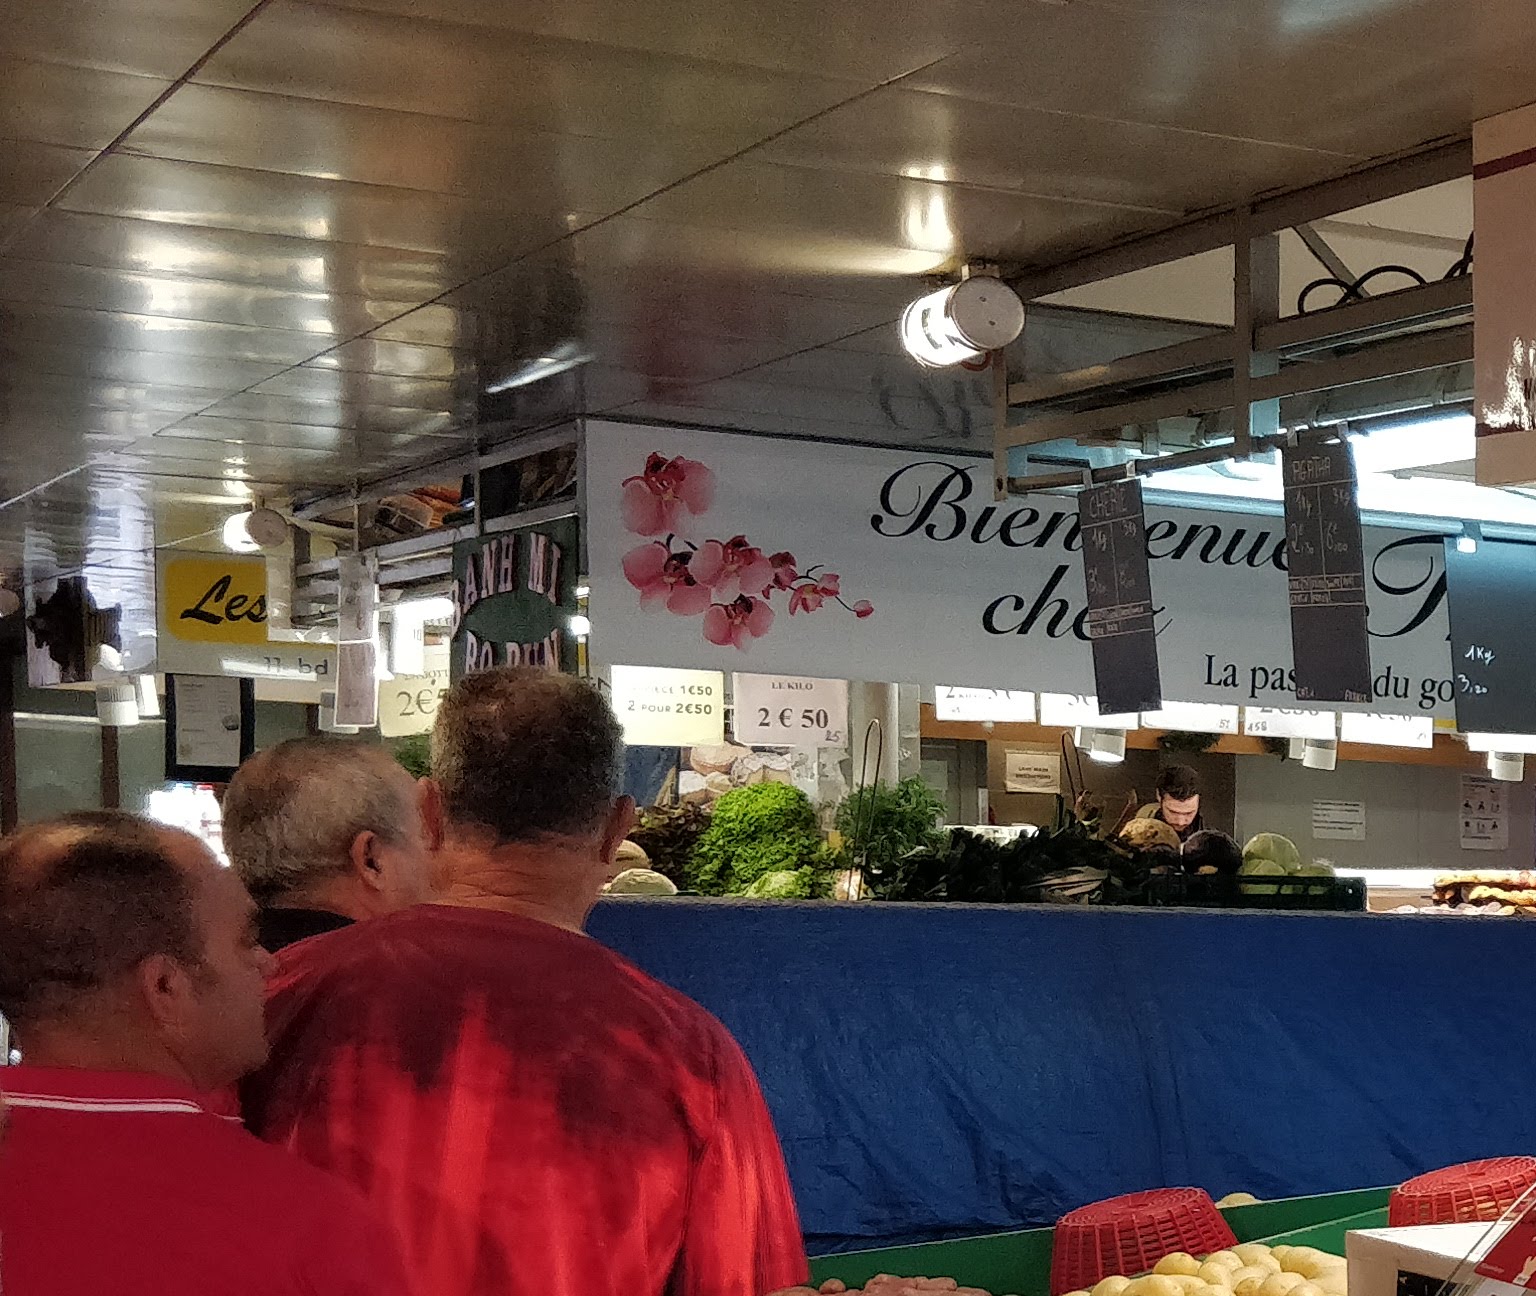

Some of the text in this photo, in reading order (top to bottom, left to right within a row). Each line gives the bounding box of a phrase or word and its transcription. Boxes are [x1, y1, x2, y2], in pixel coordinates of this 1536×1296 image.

[528, 531, 561, 605] MI
[180, 574, 268, 625] Les
[298, 658, 329, 676] bd
[1205, 652, 1239, 689] La
[1374, 666, 1410, 699] du
[680, 685, 713, 696] 1€50
[771, 681, 813, 691] LE KILO
[627, 700, 712, 715] 2 POUR 2€50
[758, 707, 829, 729] 2 € 50
